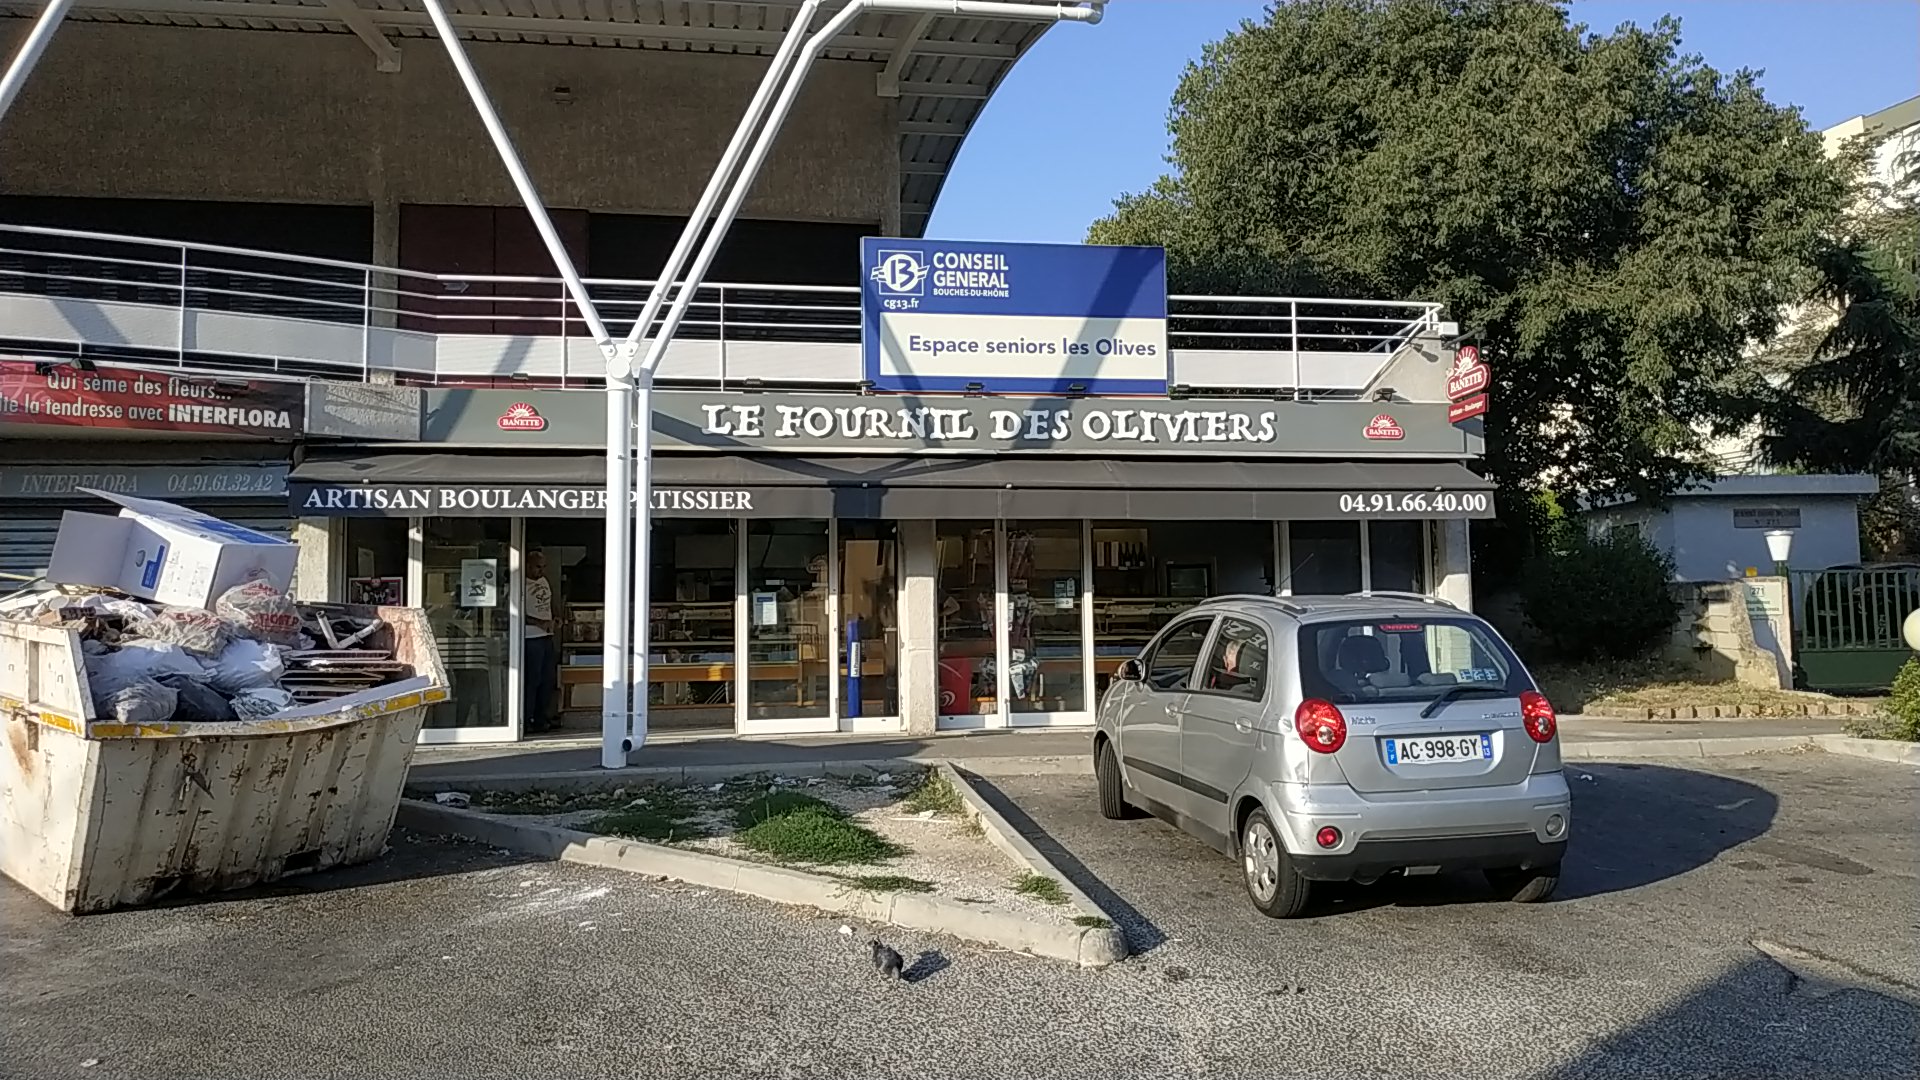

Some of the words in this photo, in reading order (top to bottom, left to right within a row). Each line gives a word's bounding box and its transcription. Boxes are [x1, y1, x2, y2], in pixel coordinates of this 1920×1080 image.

[933, 252, 1009, 270] CONSEIL
[933, 270, 1009, 288] GENERAL
[933, 288, 1010, 297] BOUCHES-DU-RHÔNE
[884, 298, 919, 309] cg13.fr
[909, 335, 979, 356] Espace
[986, 337, 1056, 354] seniors
[1063, 337, 1089, 355] les
[1096, 338, 1157, 356] Olives
[48, 371, 76, 390] Qui
[83, 373, 127, 392] sème
[134, 375, 161, 395] des
[168, 377, 231, 400] fleurs...
[1450, 371, 1482, 393] BANETTE
[25, 393, 40, 414] la
[46, 397, 123, 418] tendresse
[128, 406, 163, 420] avec
[168, 404, 291, 428] INTERFLORA
[502, 418, 540, 427] BANETTE
[702, 404, 762, 436] LE
[775, 405, 975, 439] FOURNIL
[990, 410, 1070, 440] DES
[1082, 409, 1277, 442] OLIVIERS
[1368, 428, 1400, 436] BANETTE
[168, 474, 273, 493] 04.91.61.32.42
[303, 488, 431, 510] ARTISAN
[629, 490, 753, 511] PTISSIER
[1340, 493, 1487, 512] 04.91.66.40.00
[1751, 587, 1764, 595] 271
[1400, 738, 1479, 761] AC-998-GY
